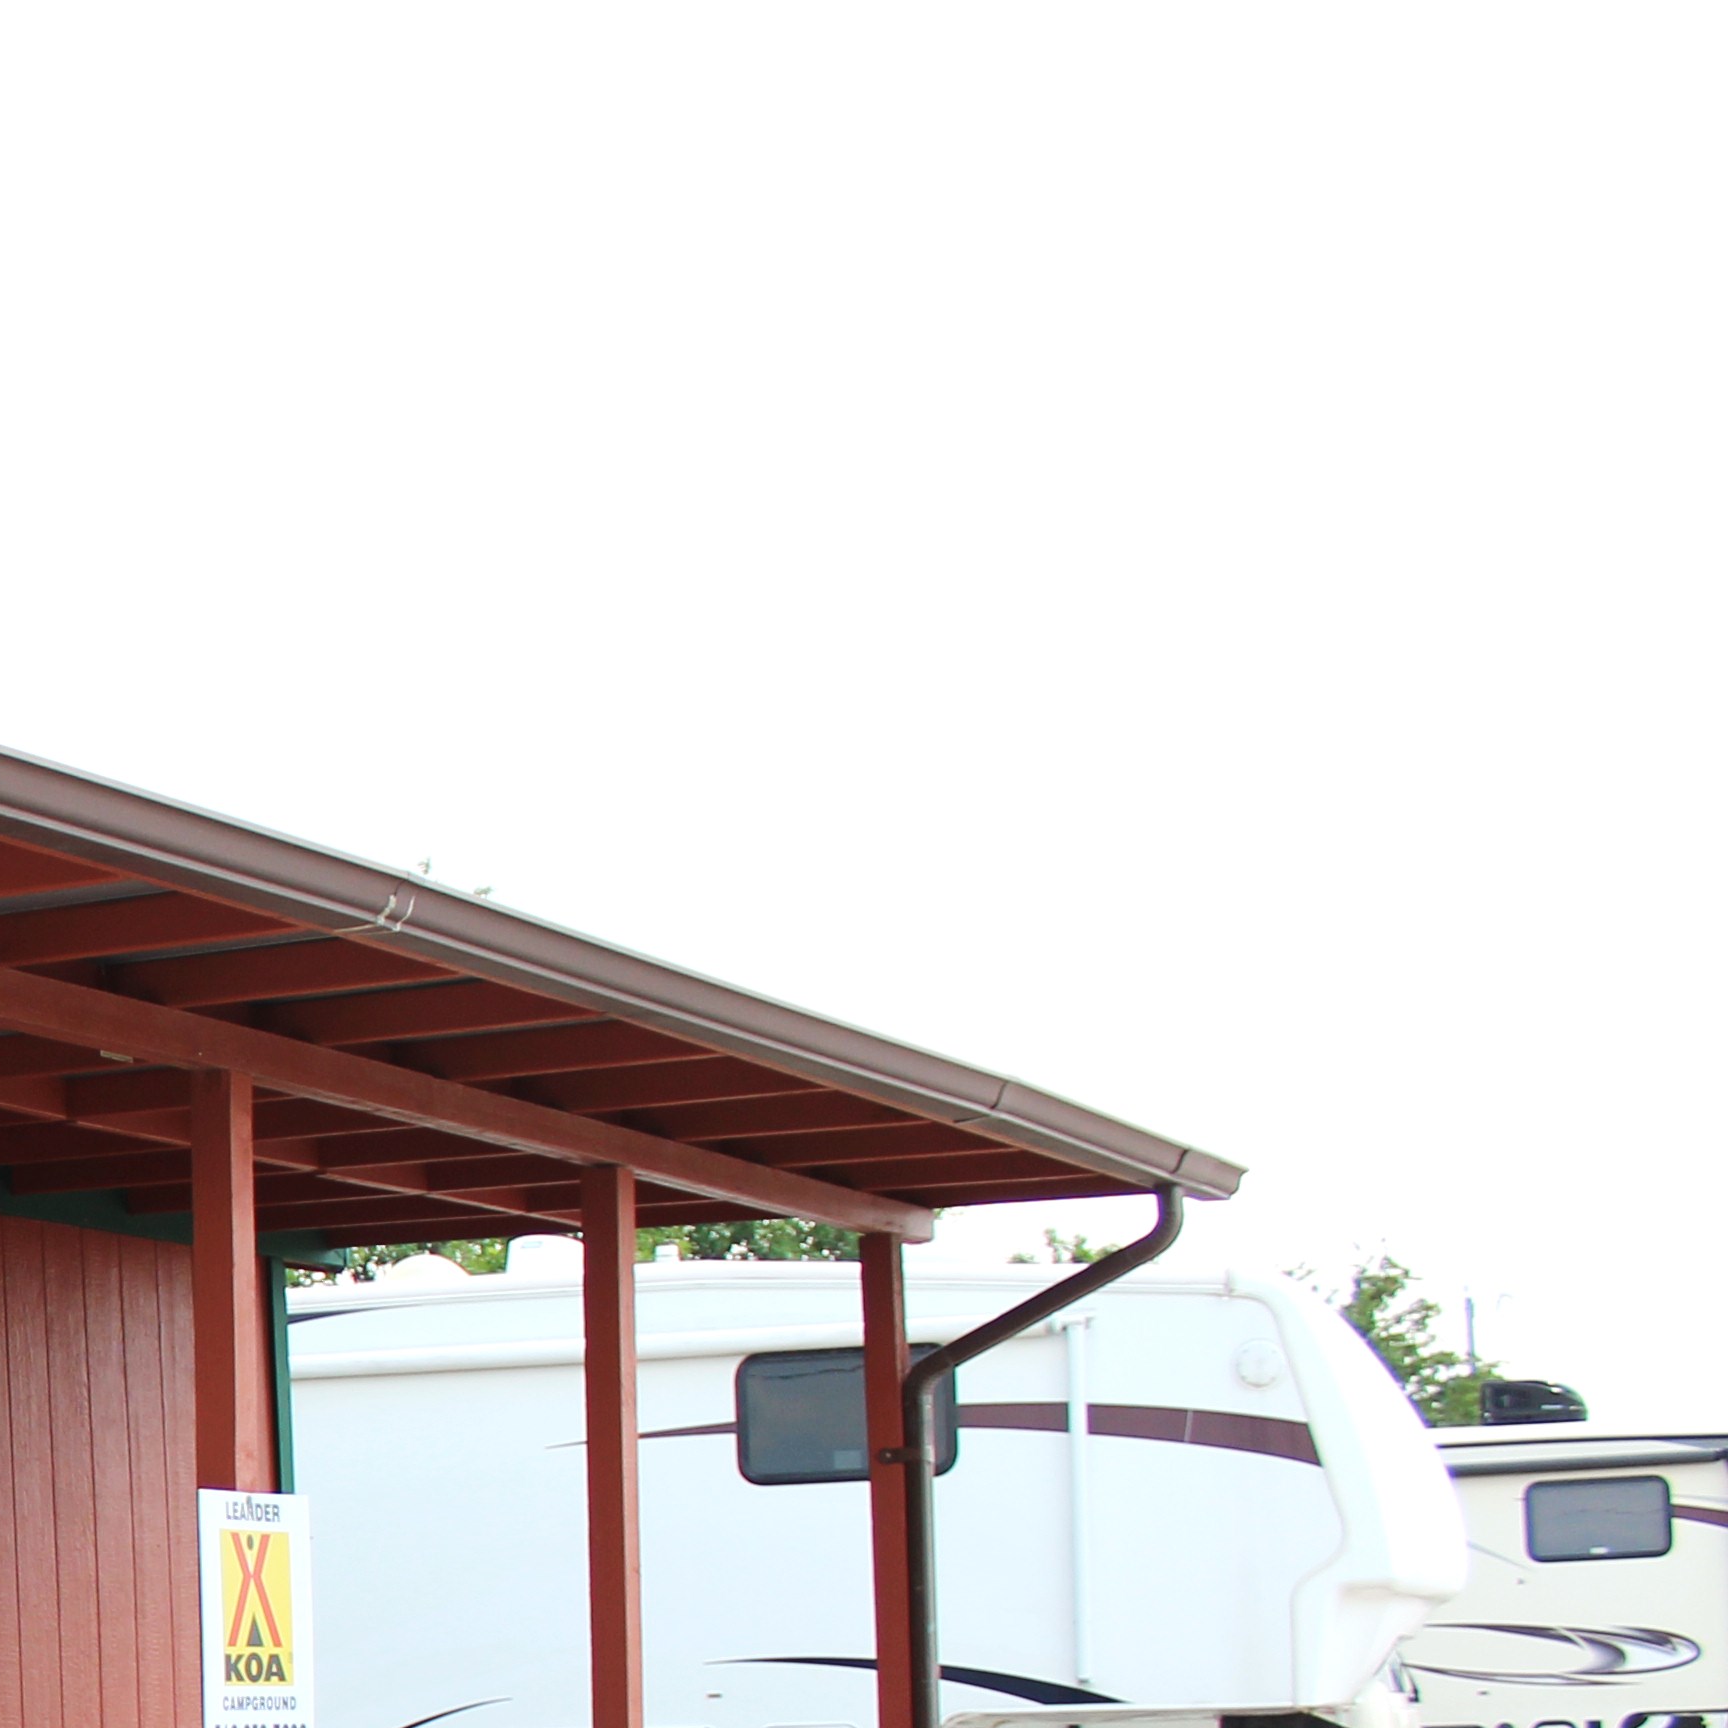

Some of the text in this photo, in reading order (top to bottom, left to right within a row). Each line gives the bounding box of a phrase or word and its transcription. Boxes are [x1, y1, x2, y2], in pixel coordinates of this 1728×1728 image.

[225, 1501, 281, 1522] LEANDER
[224, 1652, 287, 1683] KOA
[223, 1695, 297, 1711] CAMPGROUND
